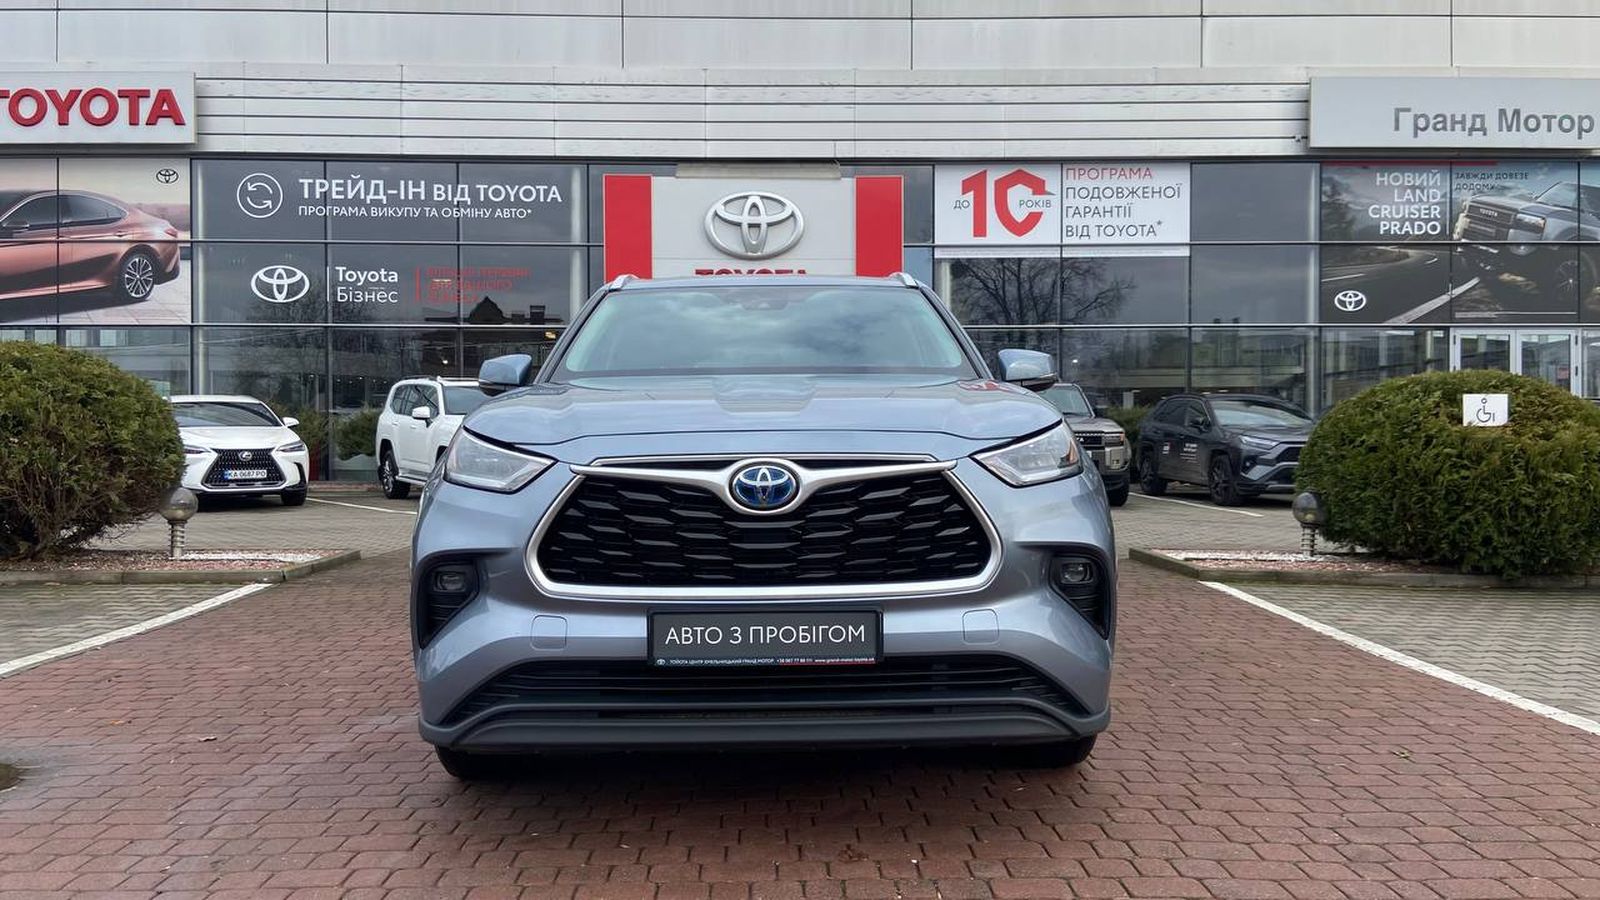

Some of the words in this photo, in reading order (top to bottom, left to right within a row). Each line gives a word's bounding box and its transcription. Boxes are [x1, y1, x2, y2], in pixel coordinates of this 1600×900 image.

[1394, 107, 1487, 137] Гранд
[1498, 108, 1595, 139] Мотор
[1065, 167, 1153, 180] ПРОГРАМА
[1376, 170, 1441, 186] НОВИЙ
[1455, 172, 1493, 181] ЗАВЖДИ
[1494, 172, 1528, 181] ДОВЕЗЕ
[298, 174, 426, 204] ТРЕЙД-ІН
[433, 184, 471, 205] ВІД
[476, 184, 562, 203] TOYOTA
[1066, 183, 1182, 201] ПОДОВЖЕНОЇ
[1394, 188, 1441, 202] LAND
[953, 200, 970, 209] ДО
[1019, 200, 1052, 208] РОКІВ
[1065, 202, 1133, 218] ГАРАНТІЇ
[1368, 204, 1441, 219] CRUISER
[298, 206, 368, 217] ПРОГРАМА
[371, 207, 421, 218] ВИКУПУ
[424, 207, 439, 218] ТА
[441, 207, 492, 219] ОБМІНУ
[1065, 225, 1091, 239] ВІД
[1379, 221, 1441, 235] PRADO
[335, 267, 398, 286] Toyota
[337, 286, 398, 303] Бізнес
[665, 626, 723, 645] АВТО
[729, 626, 742, 645] З
[749, 625, 865, 644] ПРОБІГОМ
